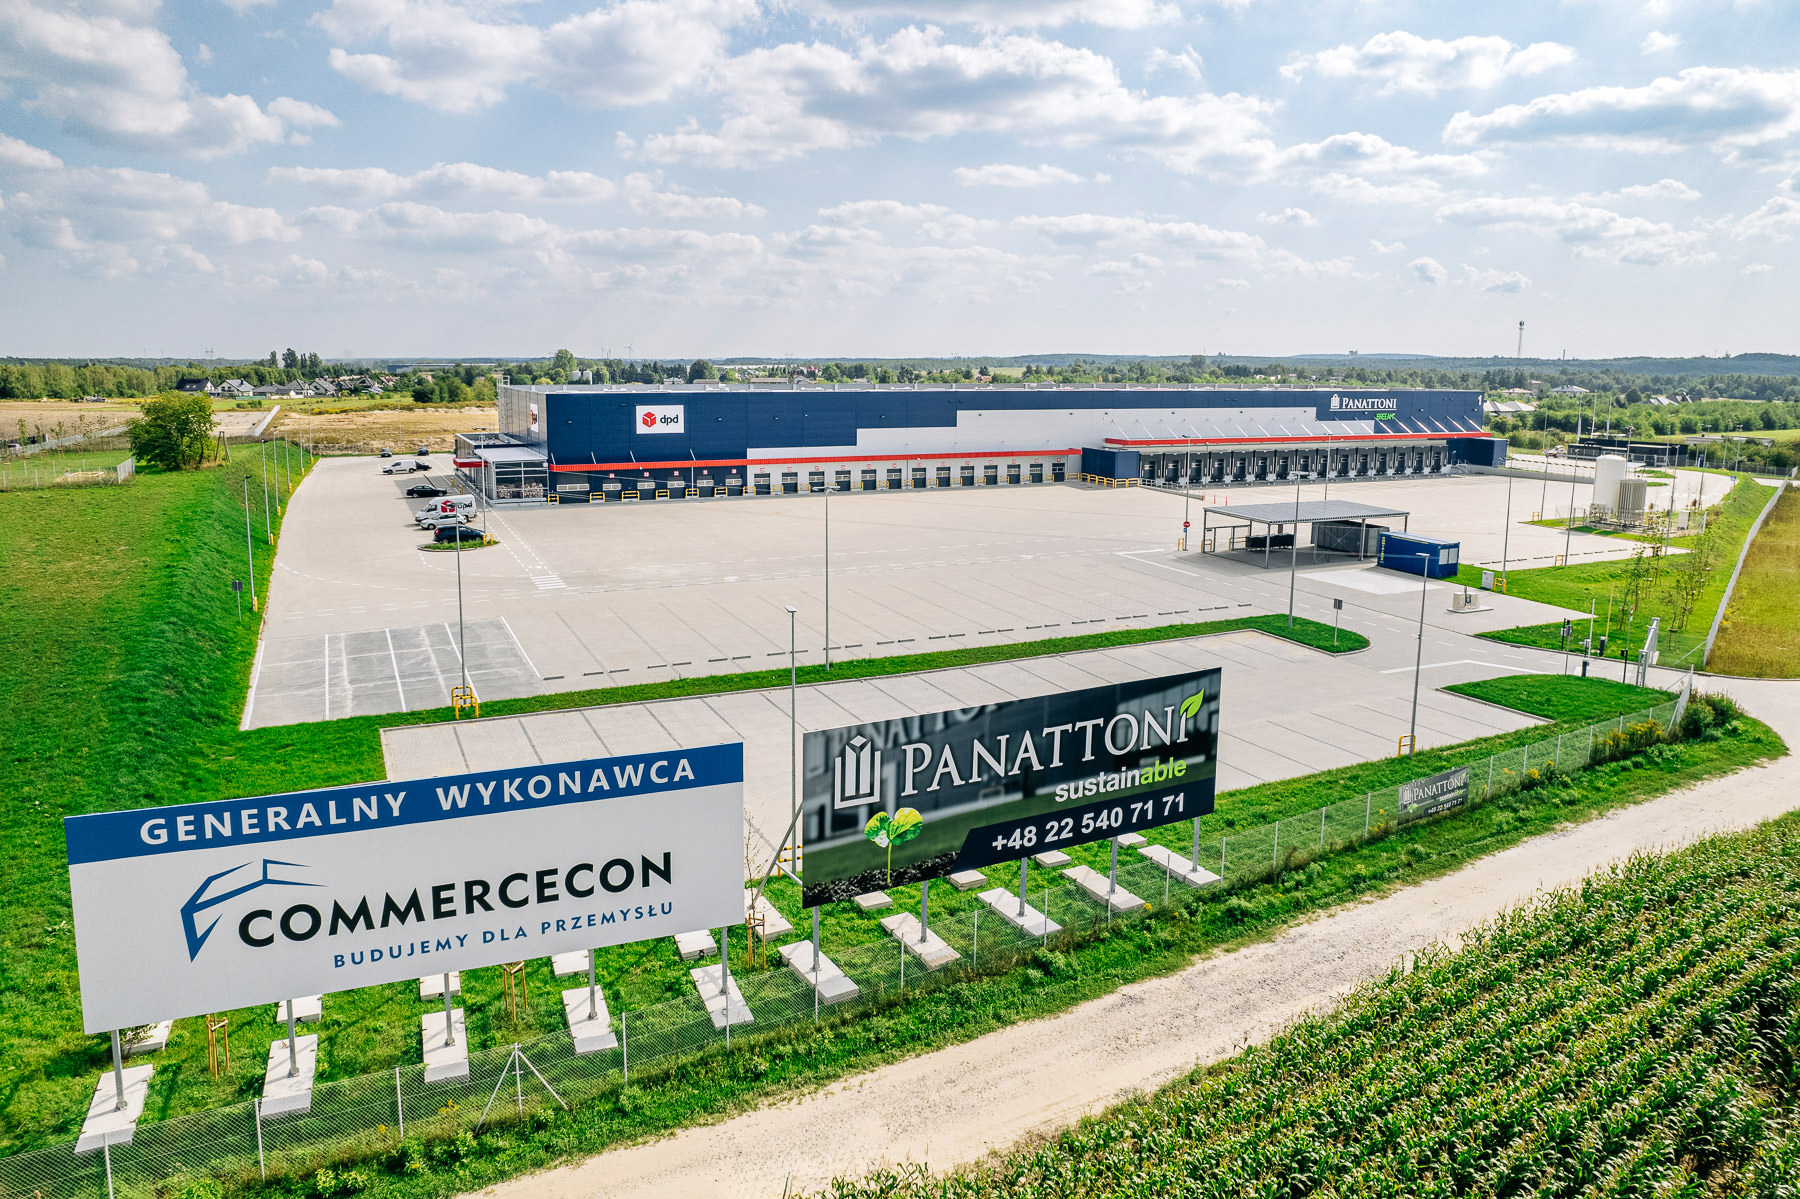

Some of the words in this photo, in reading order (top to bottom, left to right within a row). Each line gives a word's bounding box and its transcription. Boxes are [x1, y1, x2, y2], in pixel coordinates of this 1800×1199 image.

[660, 414, 679, 426] dpd
[1342, 397, 1397, 409] PANATTONI
[900, 705, 1191, 798] PANATTONI
[1053, 755, 1187, 803] sustainable
[139, 790, 408, 847] GENERALNY
[435, 756, 696, 811] WYKONAWCA
[1413, 776, 1464, 801] PANATTONI
[992, 823, 1037, 852] +48
[1044, 816, 1074, 844] 22
[1080, 806, 1123, 835] 540
[1130, 799, 1153, 824] 71
[1162, 792, 1185, 816] 71
[237, 850, 674, 948] COMMERCECON
[332, 932, 469, 969] BUDUJEMY
[481, 923, 528, 945] DLA
[540, 900, 675, 936] PRZEMYSŁU
